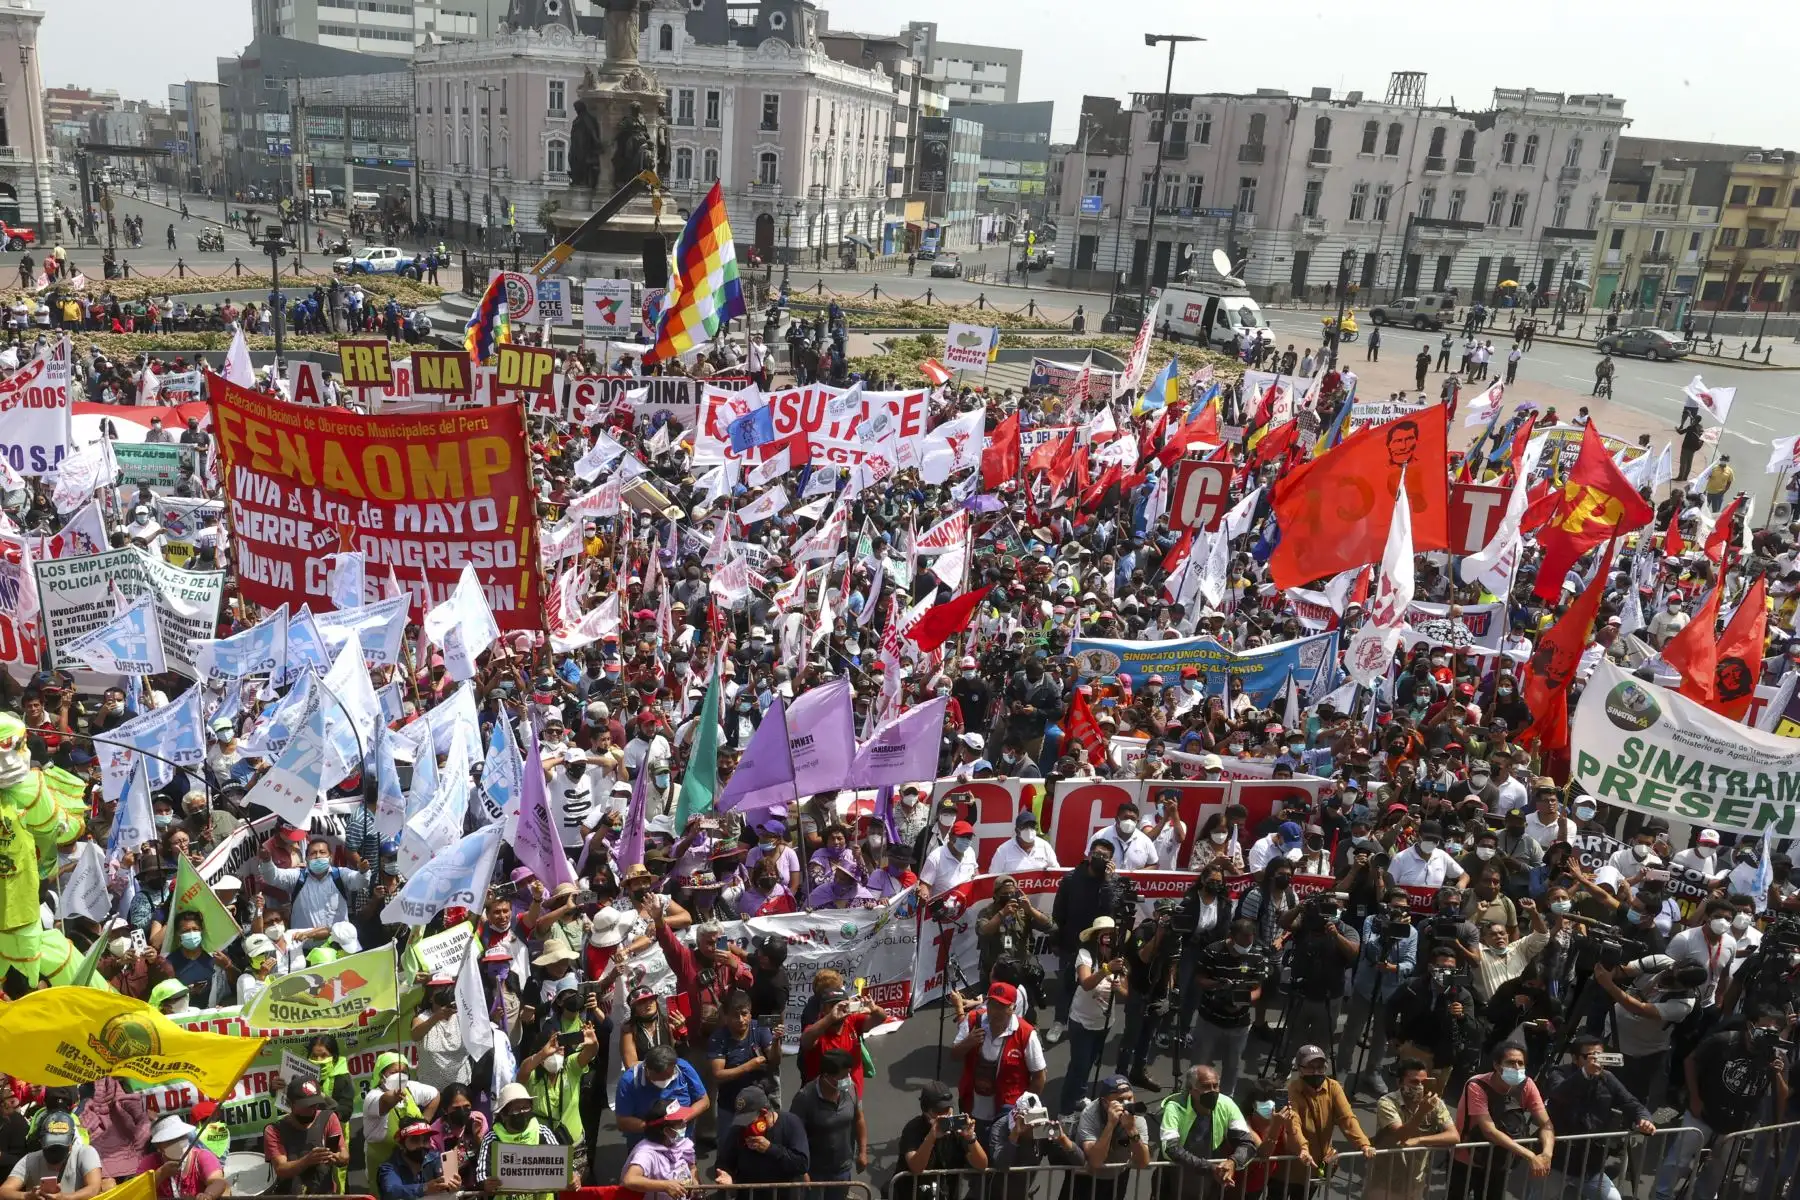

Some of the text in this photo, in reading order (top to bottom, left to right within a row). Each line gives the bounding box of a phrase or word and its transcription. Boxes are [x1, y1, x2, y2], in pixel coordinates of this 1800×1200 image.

[539, 301, 562, 310] CTE
[947, 345, 987, 358] Sombrero
[947, 352, 983, 365] Patriota
[340, 344, 391, 381] FRE
[501, 350, 552, 388] DIP
[420, 357, 464, 389] NA
[224, 387, 488, 439] Federación Nacional de Obreros Municipales del Perú
[217, 403, 512, 500] FENAOMP
[1179, 467, 1223, 528] C
[232, 499, 314, 551] CIERRE
[313, 524, 340, 549] DEL
[1463, 491, 1501, 552] T
[40, 562, 66, 578] LOS
[70, 552, 140, 573] EMPLEADOS
[189, 578, 206, 588] DE
[207, 577, 219, 588] LA
[238, 539, 294, 592] NUEVA
[49, 574, 101, 592] POLICÍA
[50, 602, 95, 618] INVOCAMOS
[97, 601, 106, 610] AL
[52, 618, 63, 627] SU
[66, 609, 108, 624] TOTALIDAD
[1123, 651, 1177, 661] SINDICATO
[1141, 664, 1154, 673] DE
[1672, 733, 1712, 752] Ministerio
[1704, 736, 1737, 750] Nacional
[1738, 744, 1748, 752] de
[164, 1087, 191, 1111] DE
[522, 1156, 564, 1165] ASAMBLEA
[500, 1167, 564, 1177] CONSTITUYENTE
